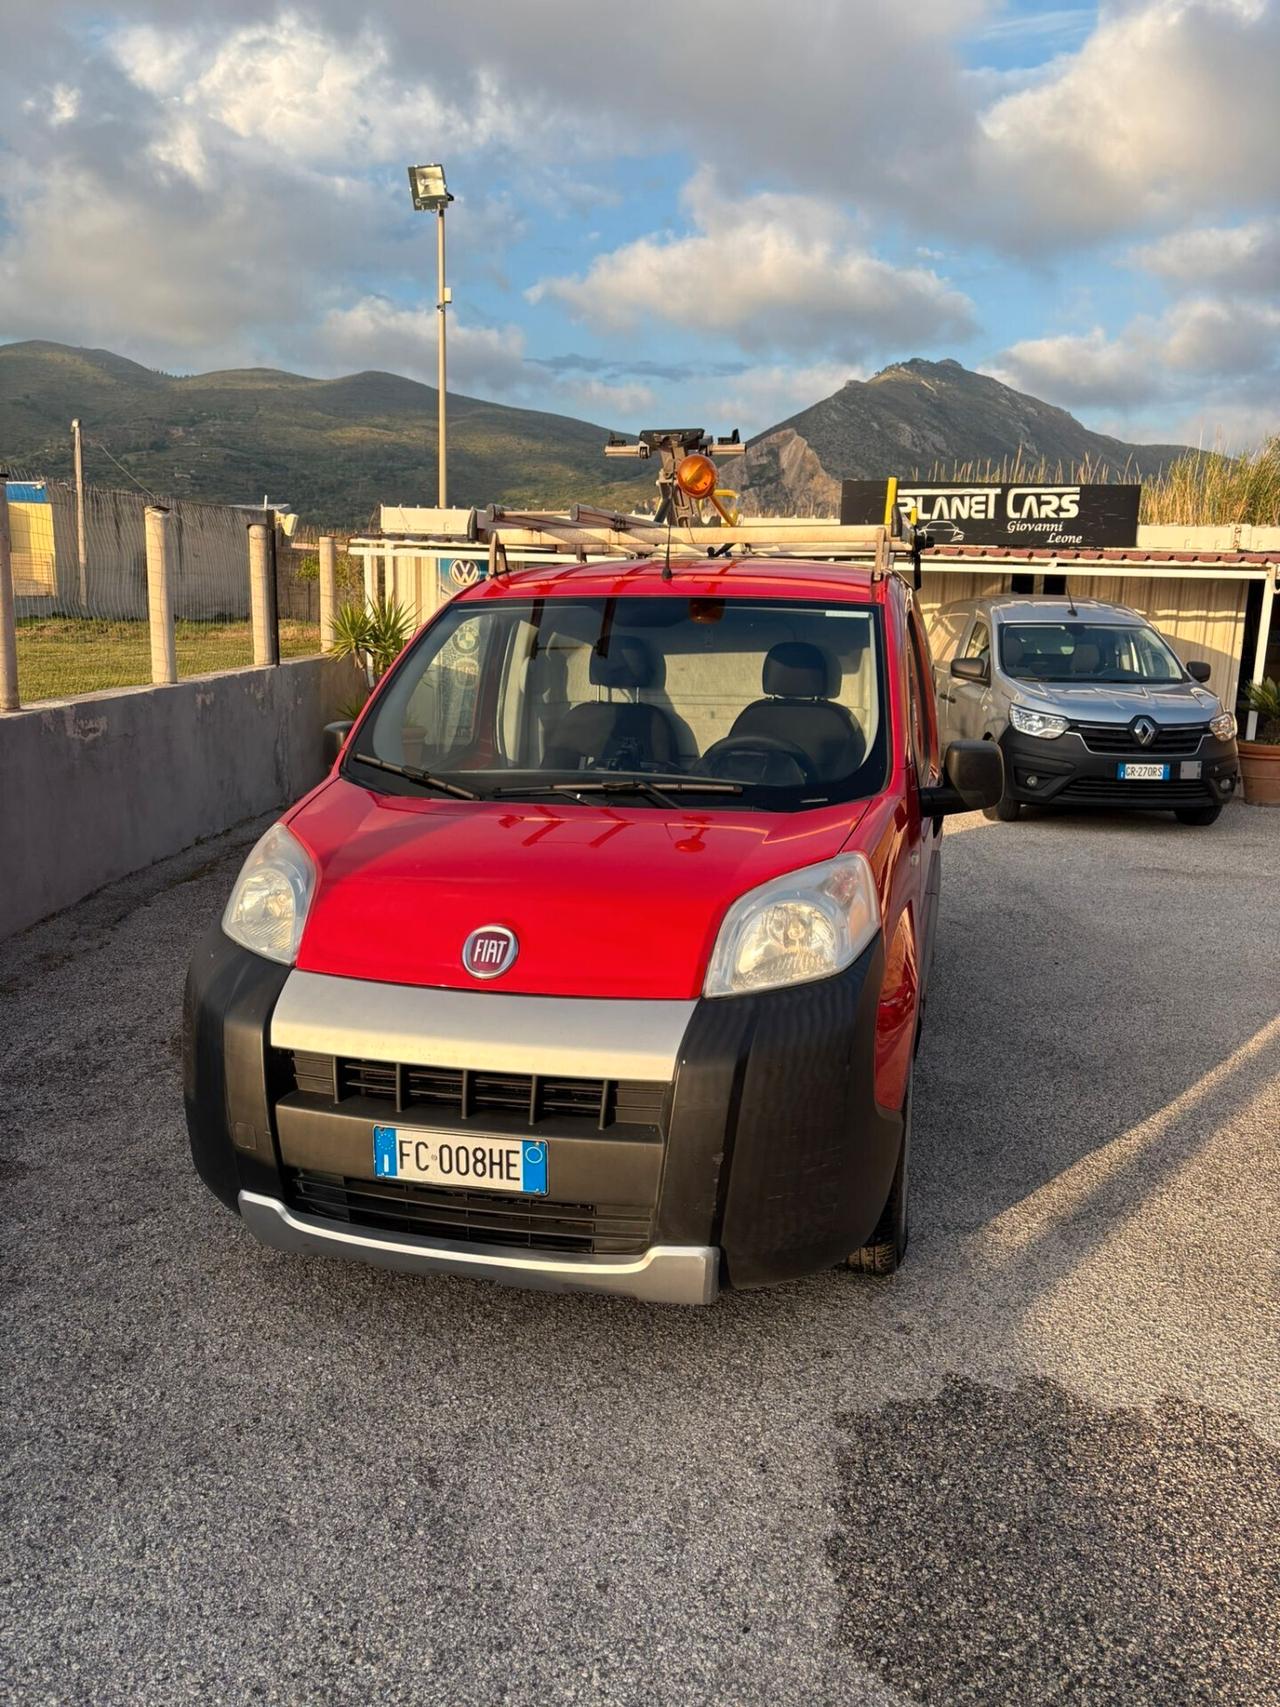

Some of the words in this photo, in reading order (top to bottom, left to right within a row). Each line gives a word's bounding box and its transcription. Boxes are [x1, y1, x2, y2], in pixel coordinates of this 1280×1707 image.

[897, 487, 1001, 519] PLANET
[1007, 486, 1080, 519] CARS
[1007, 520, 1064, 534] Giovanni
[1046, 532, 1083, 544] Leone
[473, 939, 508, 964] FIAT
